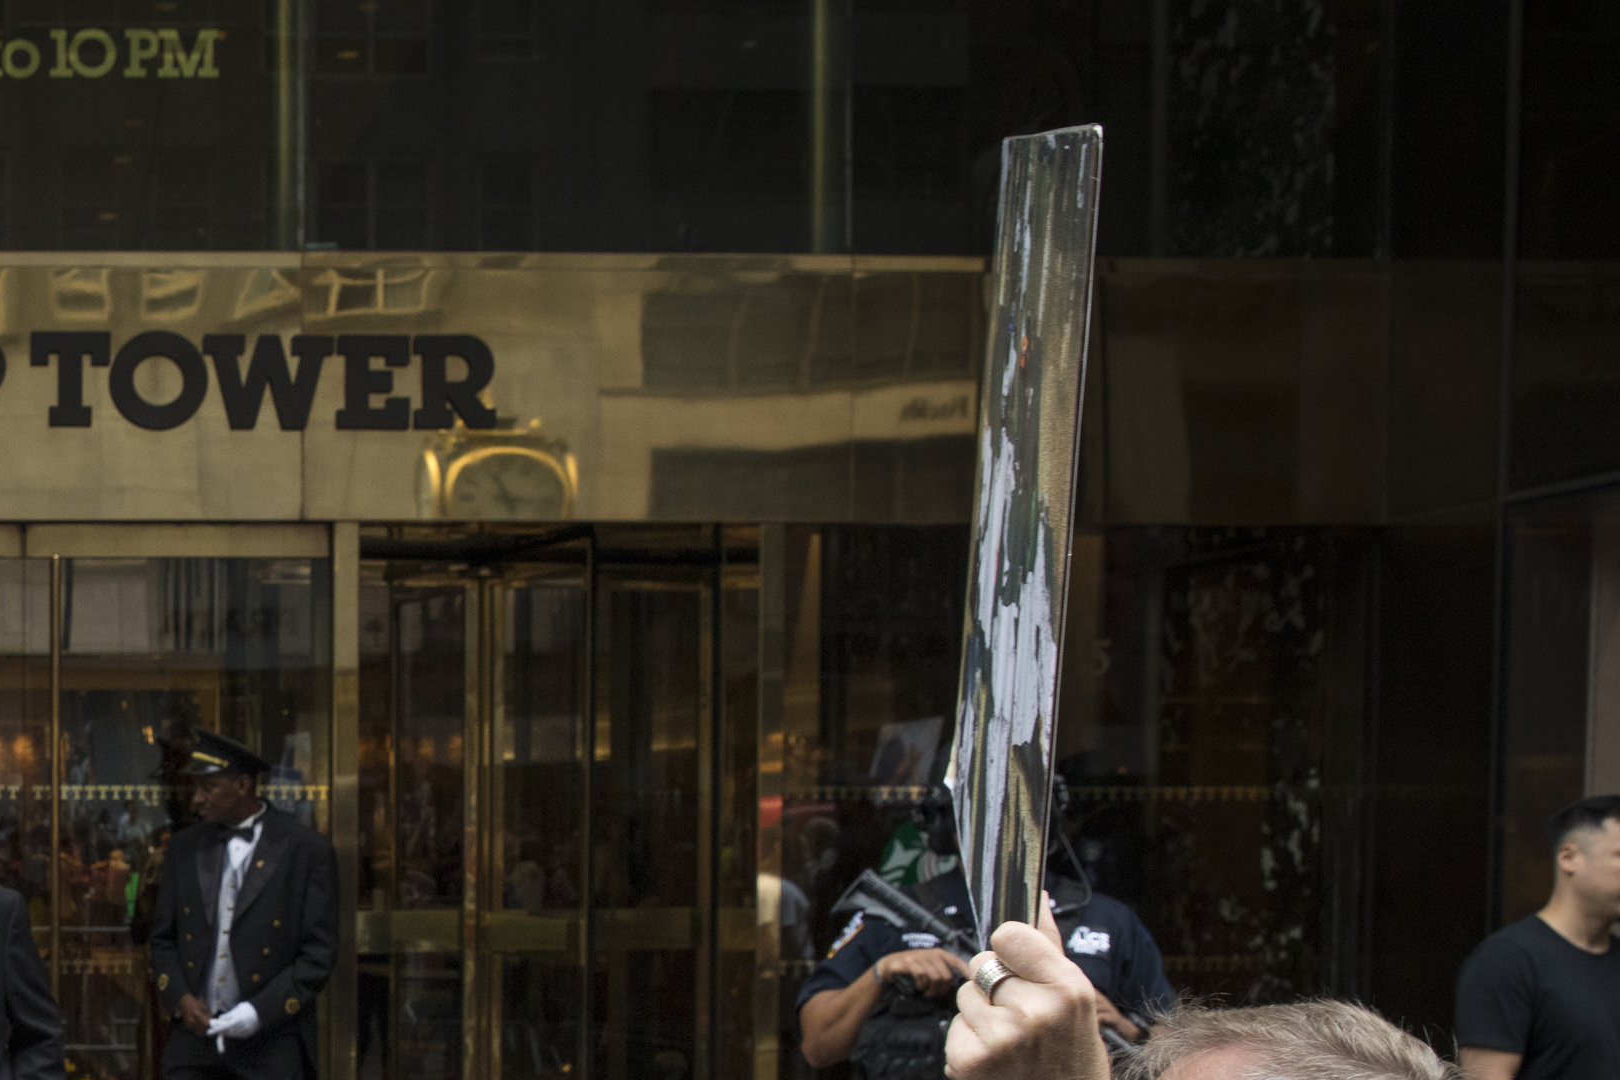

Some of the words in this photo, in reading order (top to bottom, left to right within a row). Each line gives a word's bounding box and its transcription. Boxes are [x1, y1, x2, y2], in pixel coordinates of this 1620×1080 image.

[49, 28, 118, 79] 10
[124, 28, 220, 79] PM
[30, 330, 497, 432] TOWER
